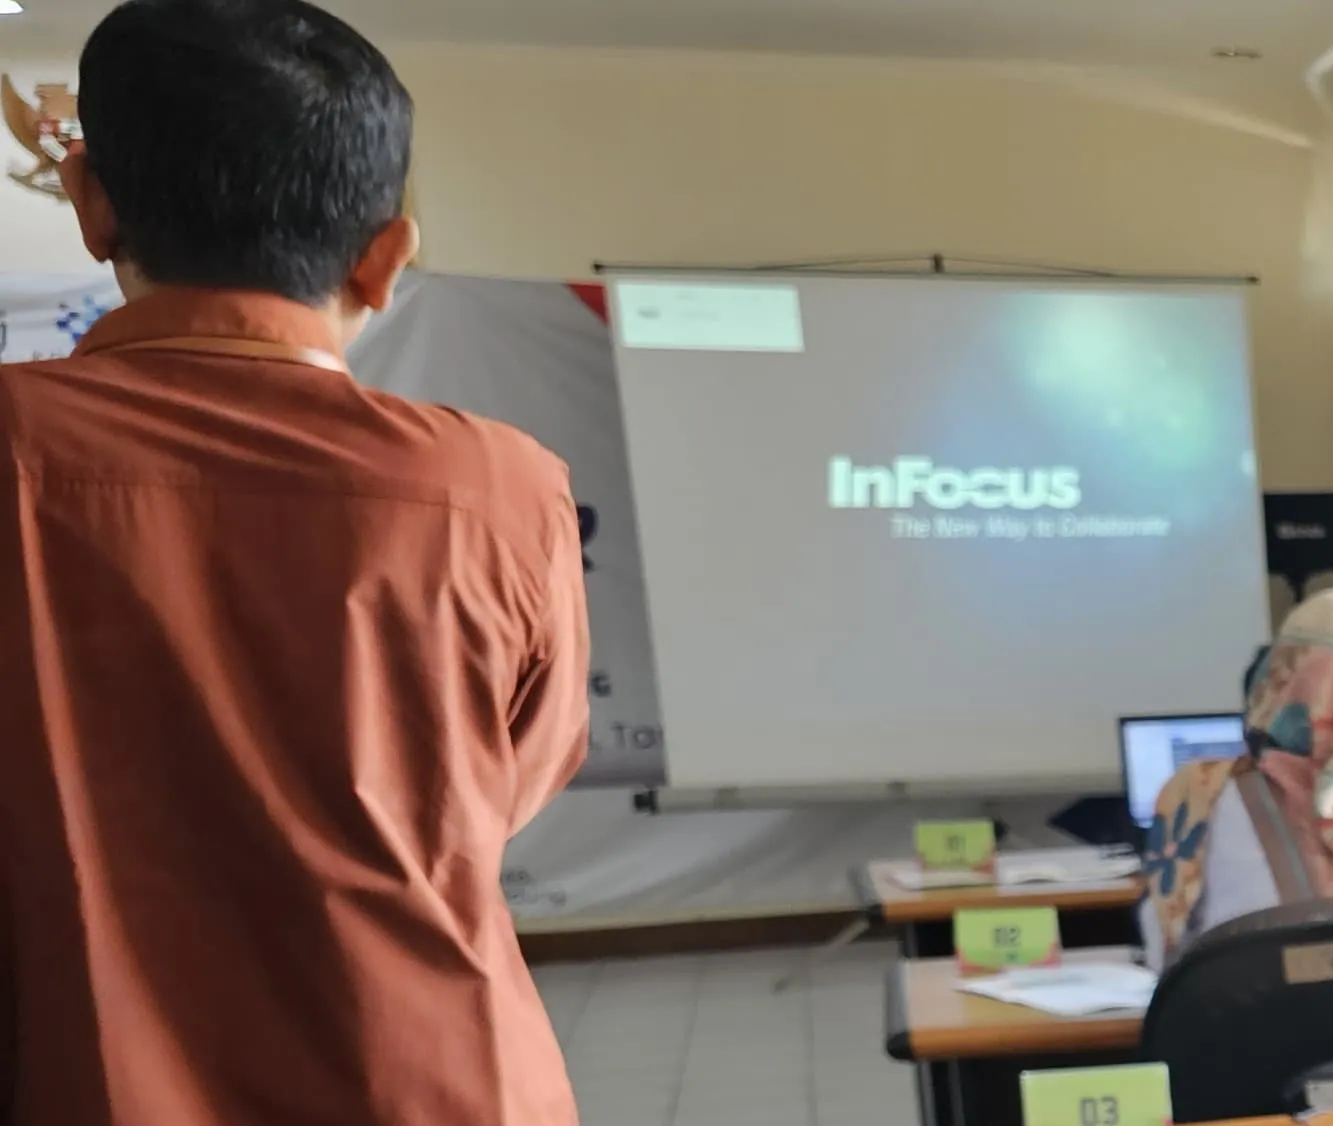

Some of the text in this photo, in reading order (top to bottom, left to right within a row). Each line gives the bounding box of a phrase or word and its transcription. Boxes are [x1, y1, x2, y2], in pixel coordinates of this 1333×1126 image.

[828, 455, 1082, 510] InFocus
[890, 516, 930, 539] The
[932, 517, 979, 538] New
[984, 515, 1029, 541] Way
[993, 926, 1020, 947] 02
